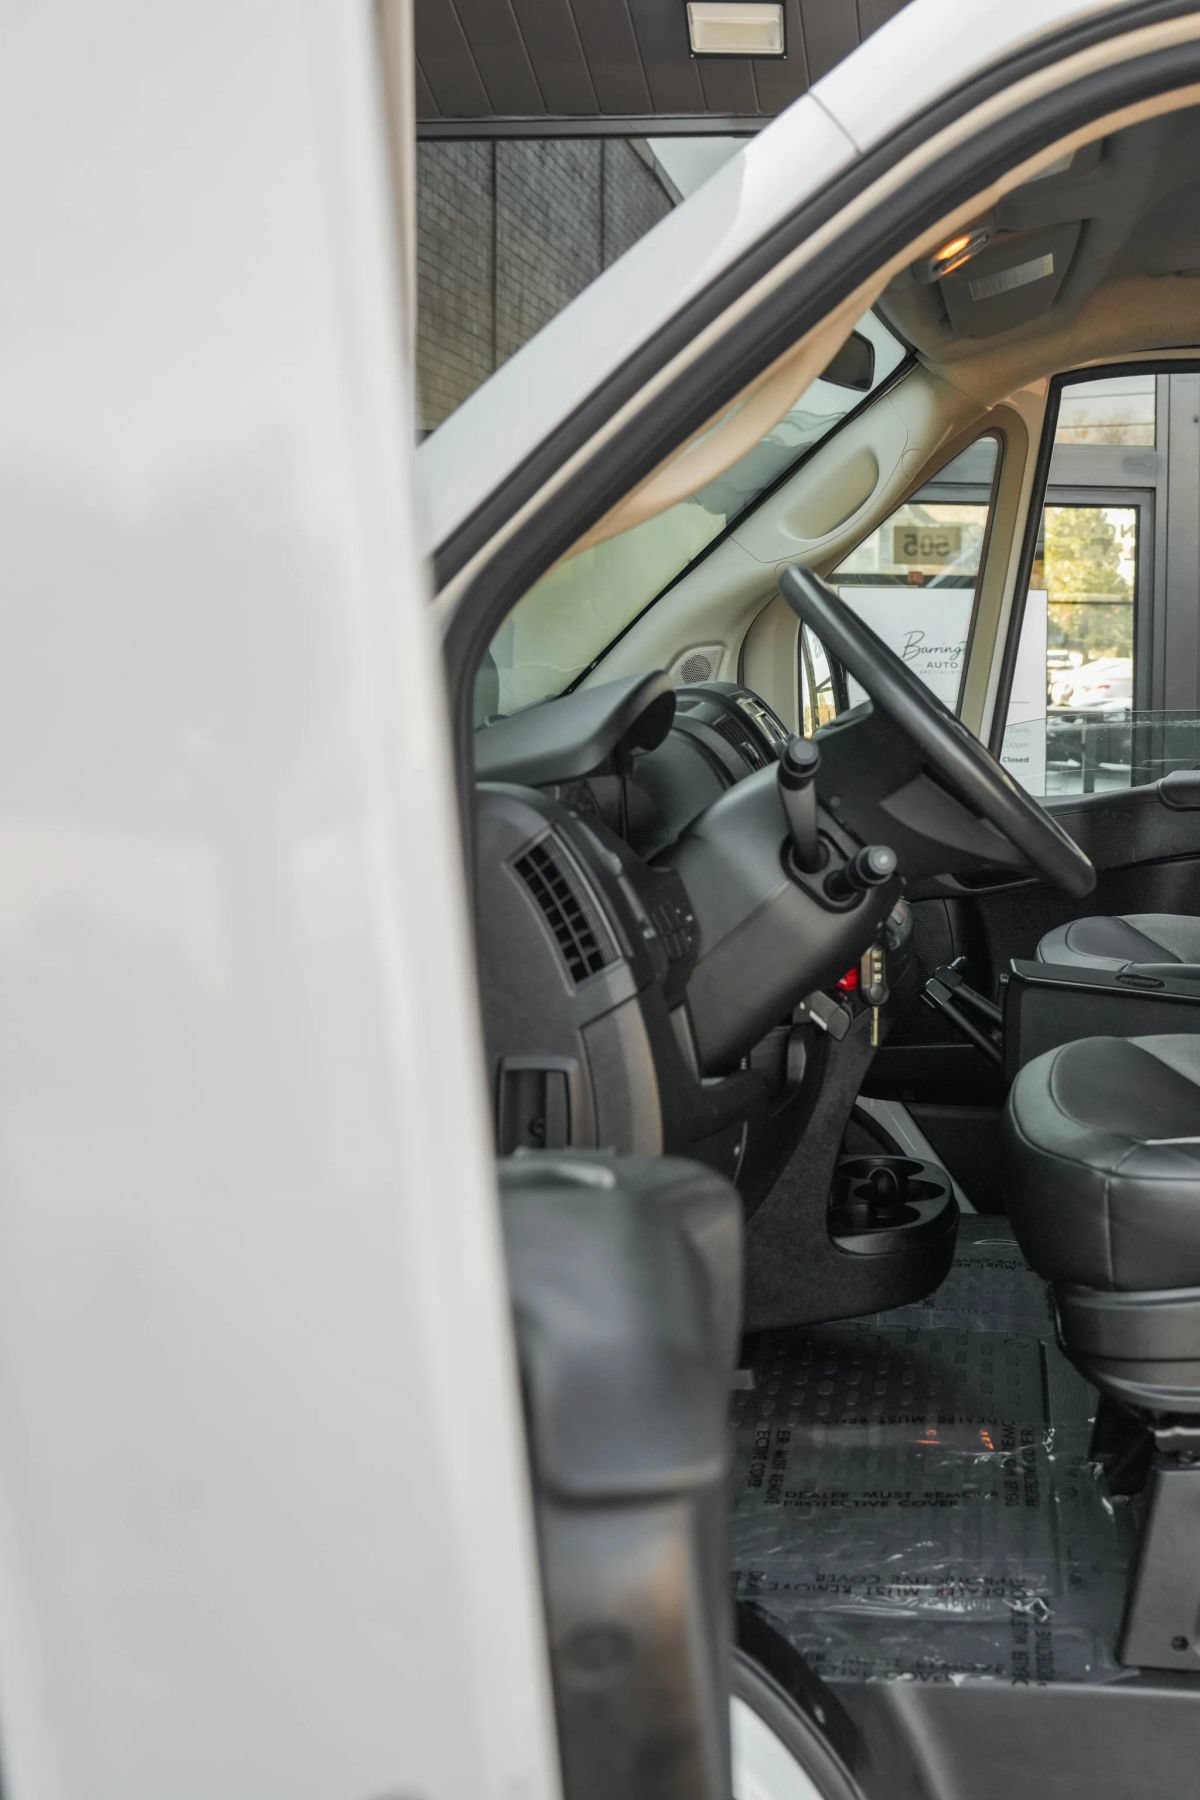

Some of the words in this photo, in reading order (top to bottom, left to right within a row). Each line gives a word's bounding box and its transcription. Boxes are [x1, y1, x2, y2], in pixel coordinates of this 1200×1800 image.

[926, 661, 958, 669] AUTO
[784, 1490, 850, 1499] DEALER
[863, 1490, 914, 1499] MUST
[898, 1499, 959, 1508] COVER
